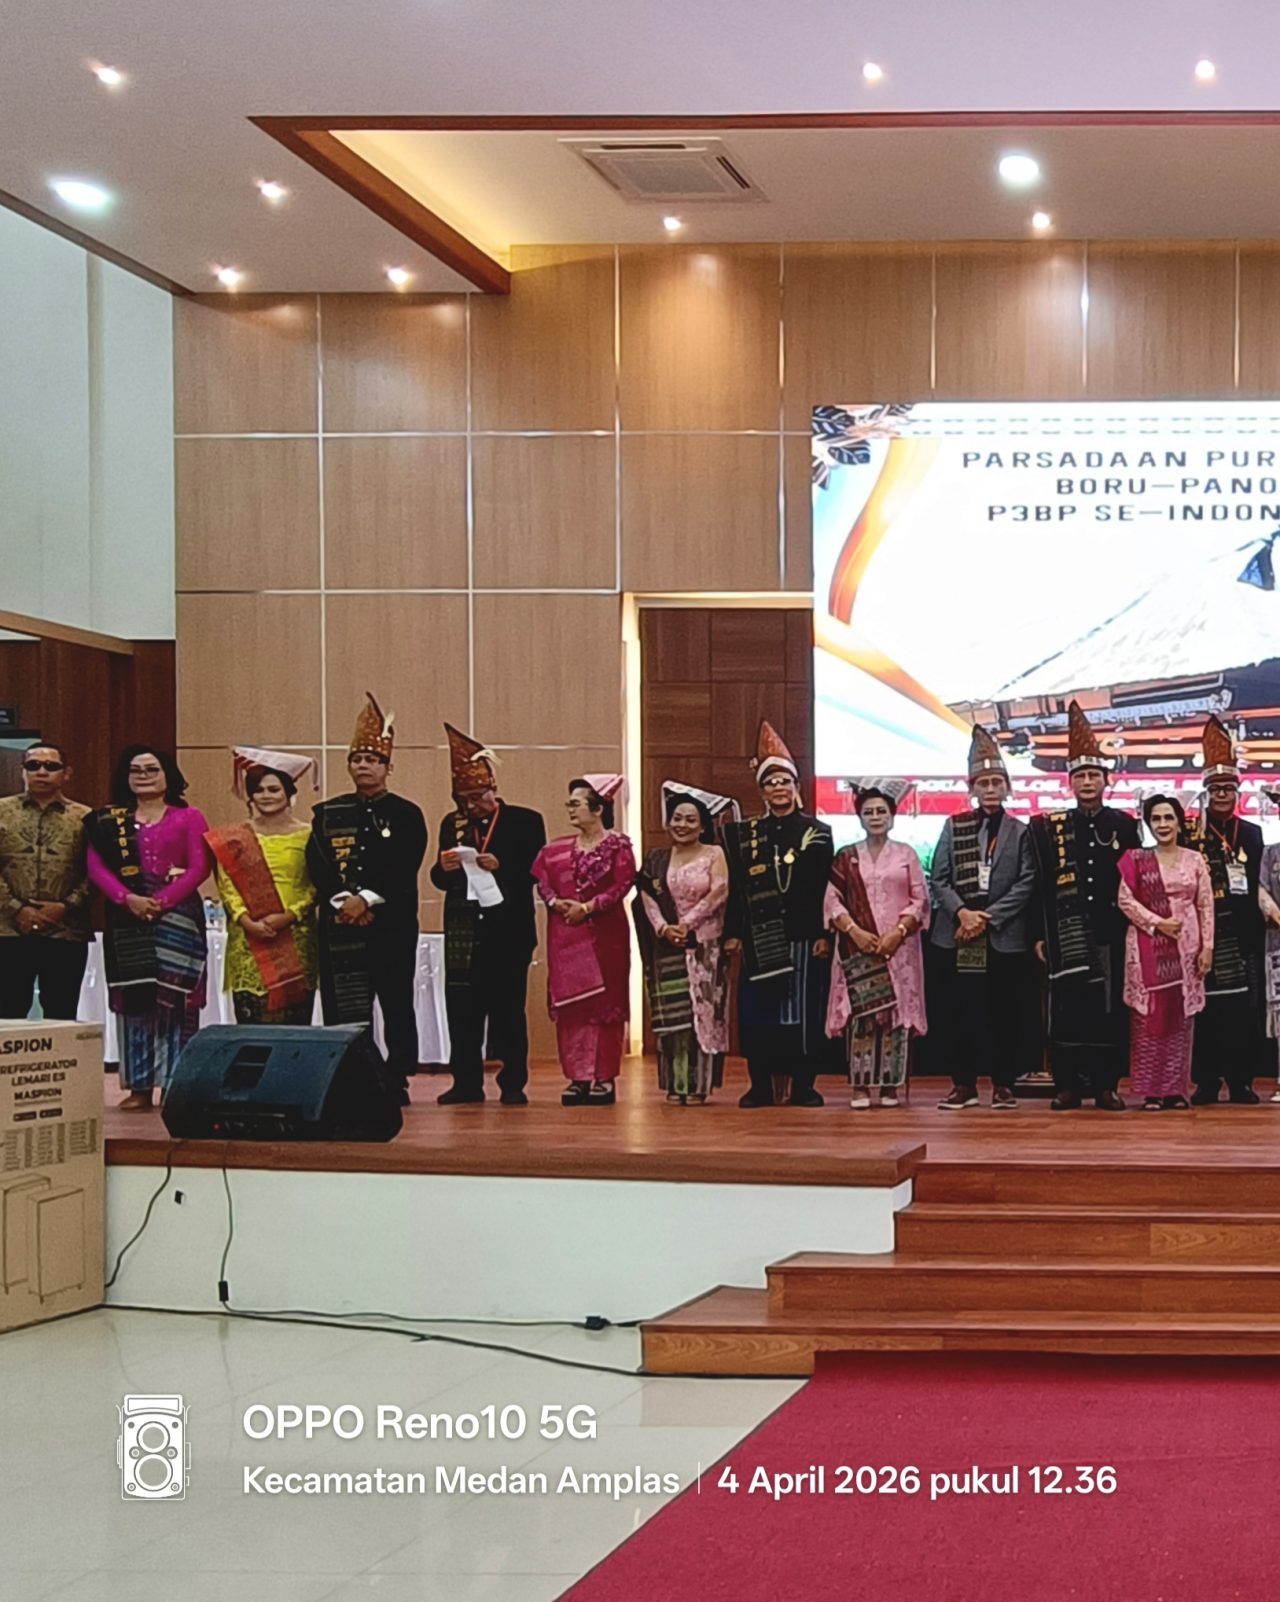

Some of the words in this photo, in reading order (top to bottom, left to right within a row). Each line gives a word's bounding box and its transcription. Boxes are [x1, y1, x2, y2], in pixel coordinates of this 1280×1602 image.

[962, 451, 1188, 468] PARSADAAN
[987, 504, 1077, 522] P3BP
[14, 1088, 62, 1100] MASPION
